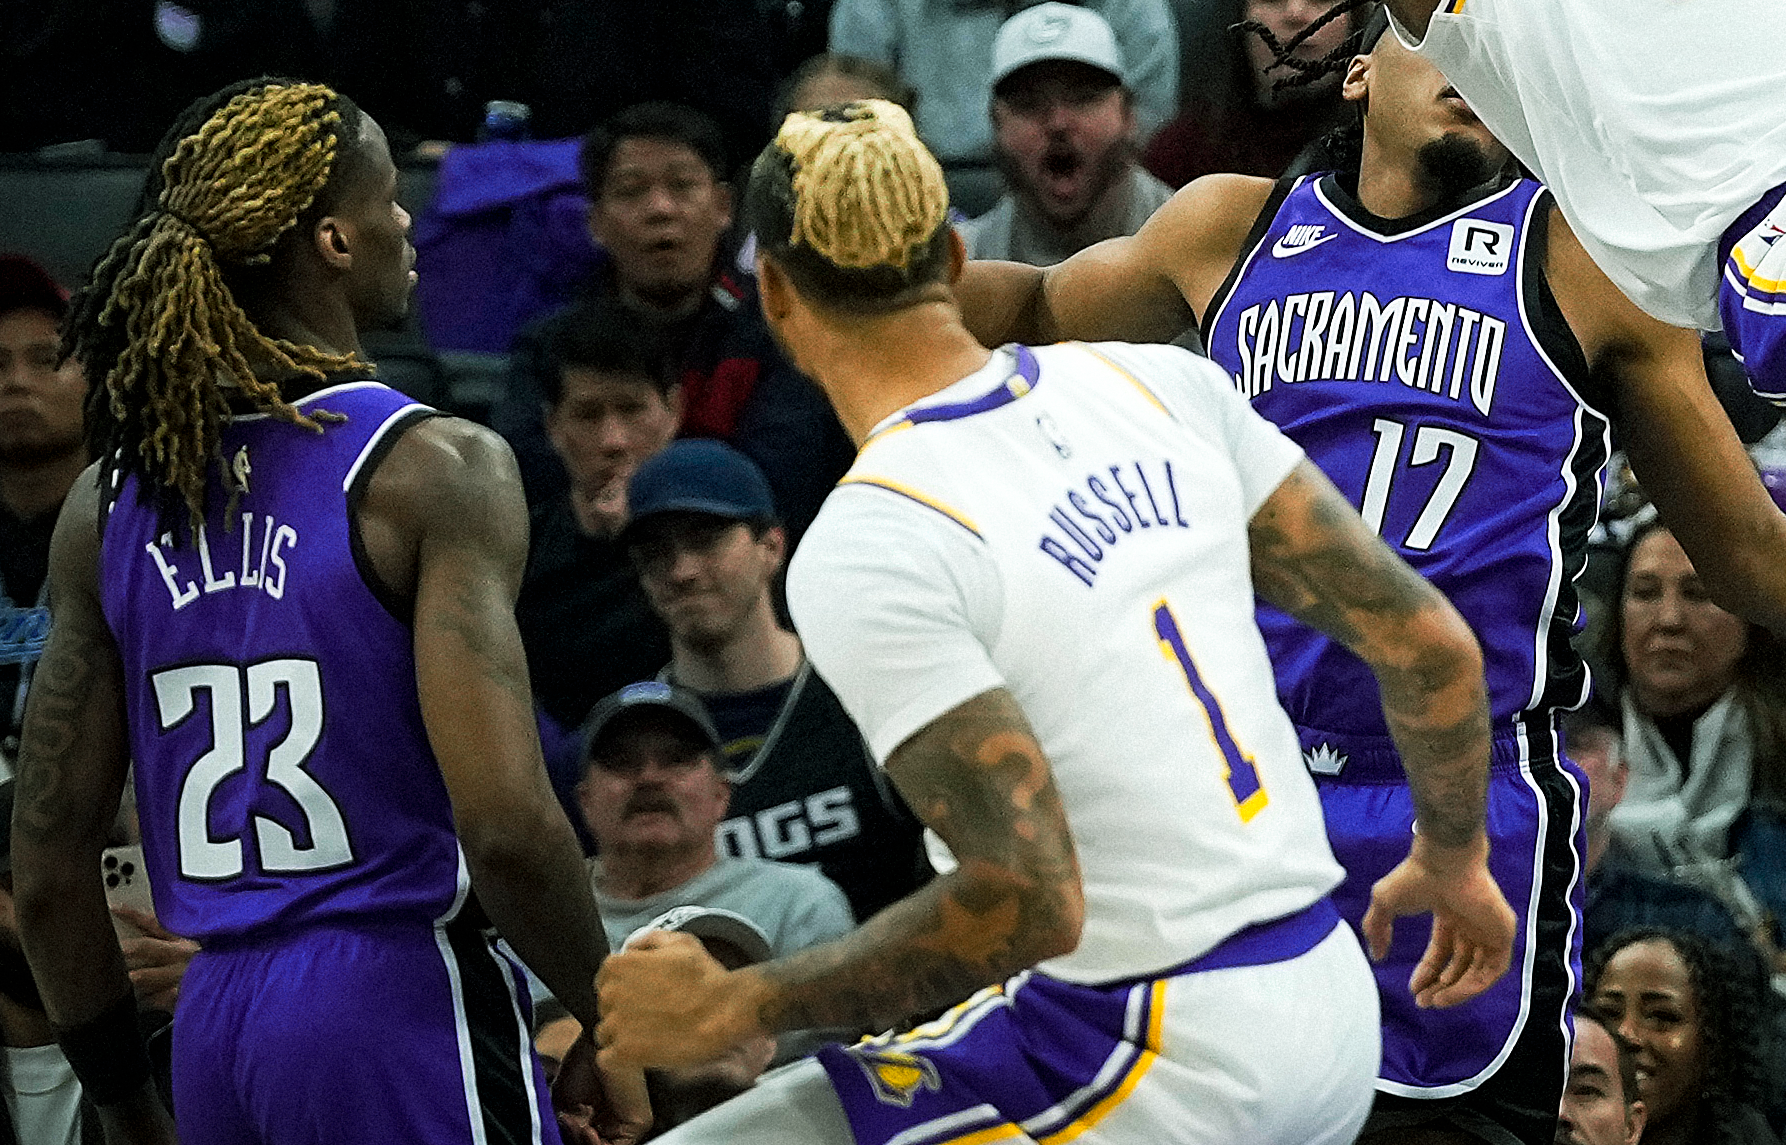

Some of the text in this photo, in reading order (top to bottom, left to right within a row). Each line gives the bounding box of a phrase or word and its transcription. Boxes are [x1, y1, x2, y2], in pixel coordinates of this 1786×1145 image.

[1282, 224, 1326, 248] NIKE
[1234, 289, 1507, 418] SACRAMENTO
[1039, 460, 1190, 589] RUSSELL
[1360, 417, 1481, 552] 17
[145, 511, 299, 611] ELLIS
[150, 657, 355, 882] 23
[1152, 596, 1269, 823] 1
